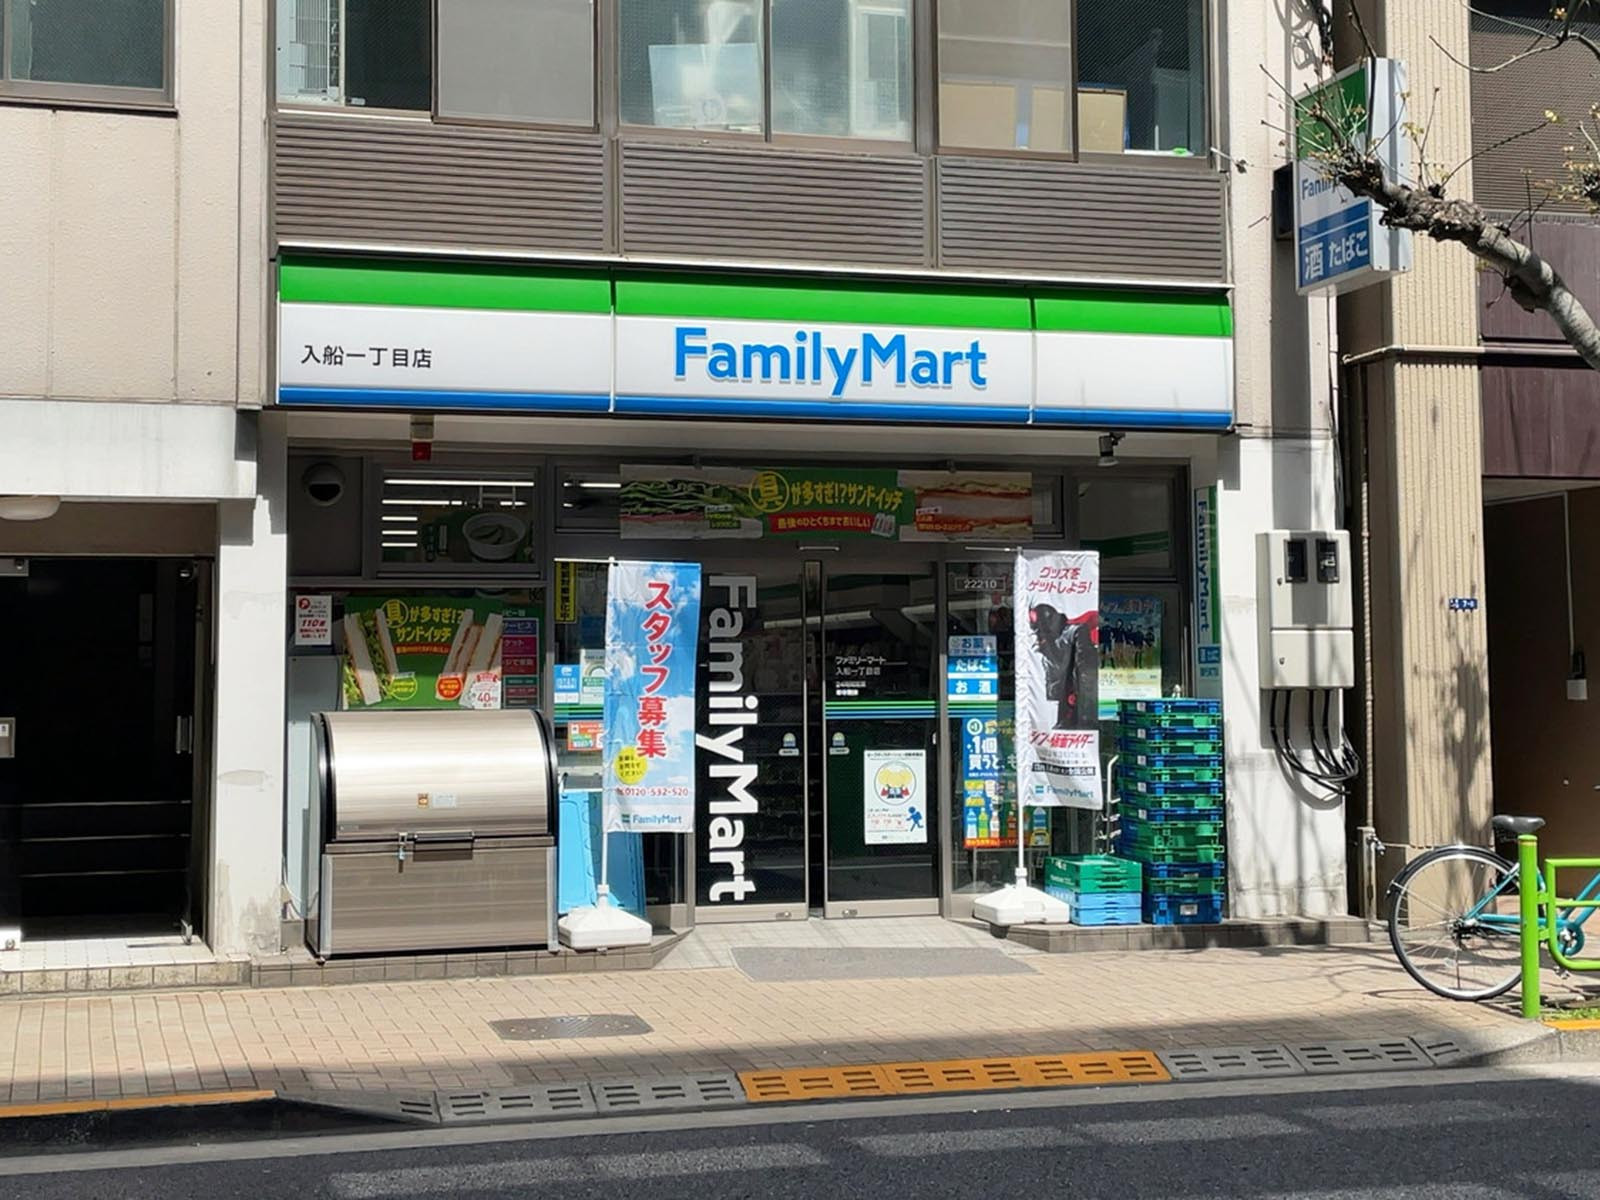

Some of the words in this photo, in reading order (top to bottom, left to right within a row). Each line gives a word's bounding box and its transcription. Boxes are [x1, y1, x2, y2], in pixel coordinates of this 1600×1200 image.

[1304, 242, 1324, 280] 酒
[1329, 230, 1368, 268] たばこ
[300, 344, 432, 369] 入船一丁目店
[674, 326, 988, 397] FamilyMart
[1039, 566, 1081, 580] グッズを
[1197, 501, 1210, 633] FamilyMart
[963, 579, 997, 589] 22210
[395, 626, 453, 642] サンドイッチ
[835, 656, 887, 665] ファミリーマート
[955, 658, 990, 672] たばこ
[636, 582, 673, 758] スタッフ募集
[696, 575, 759, 902] FamilyMart
[1047, 784, 1094, 798] FamilyMart
[633, 814, 682, 824] FamilyMart
